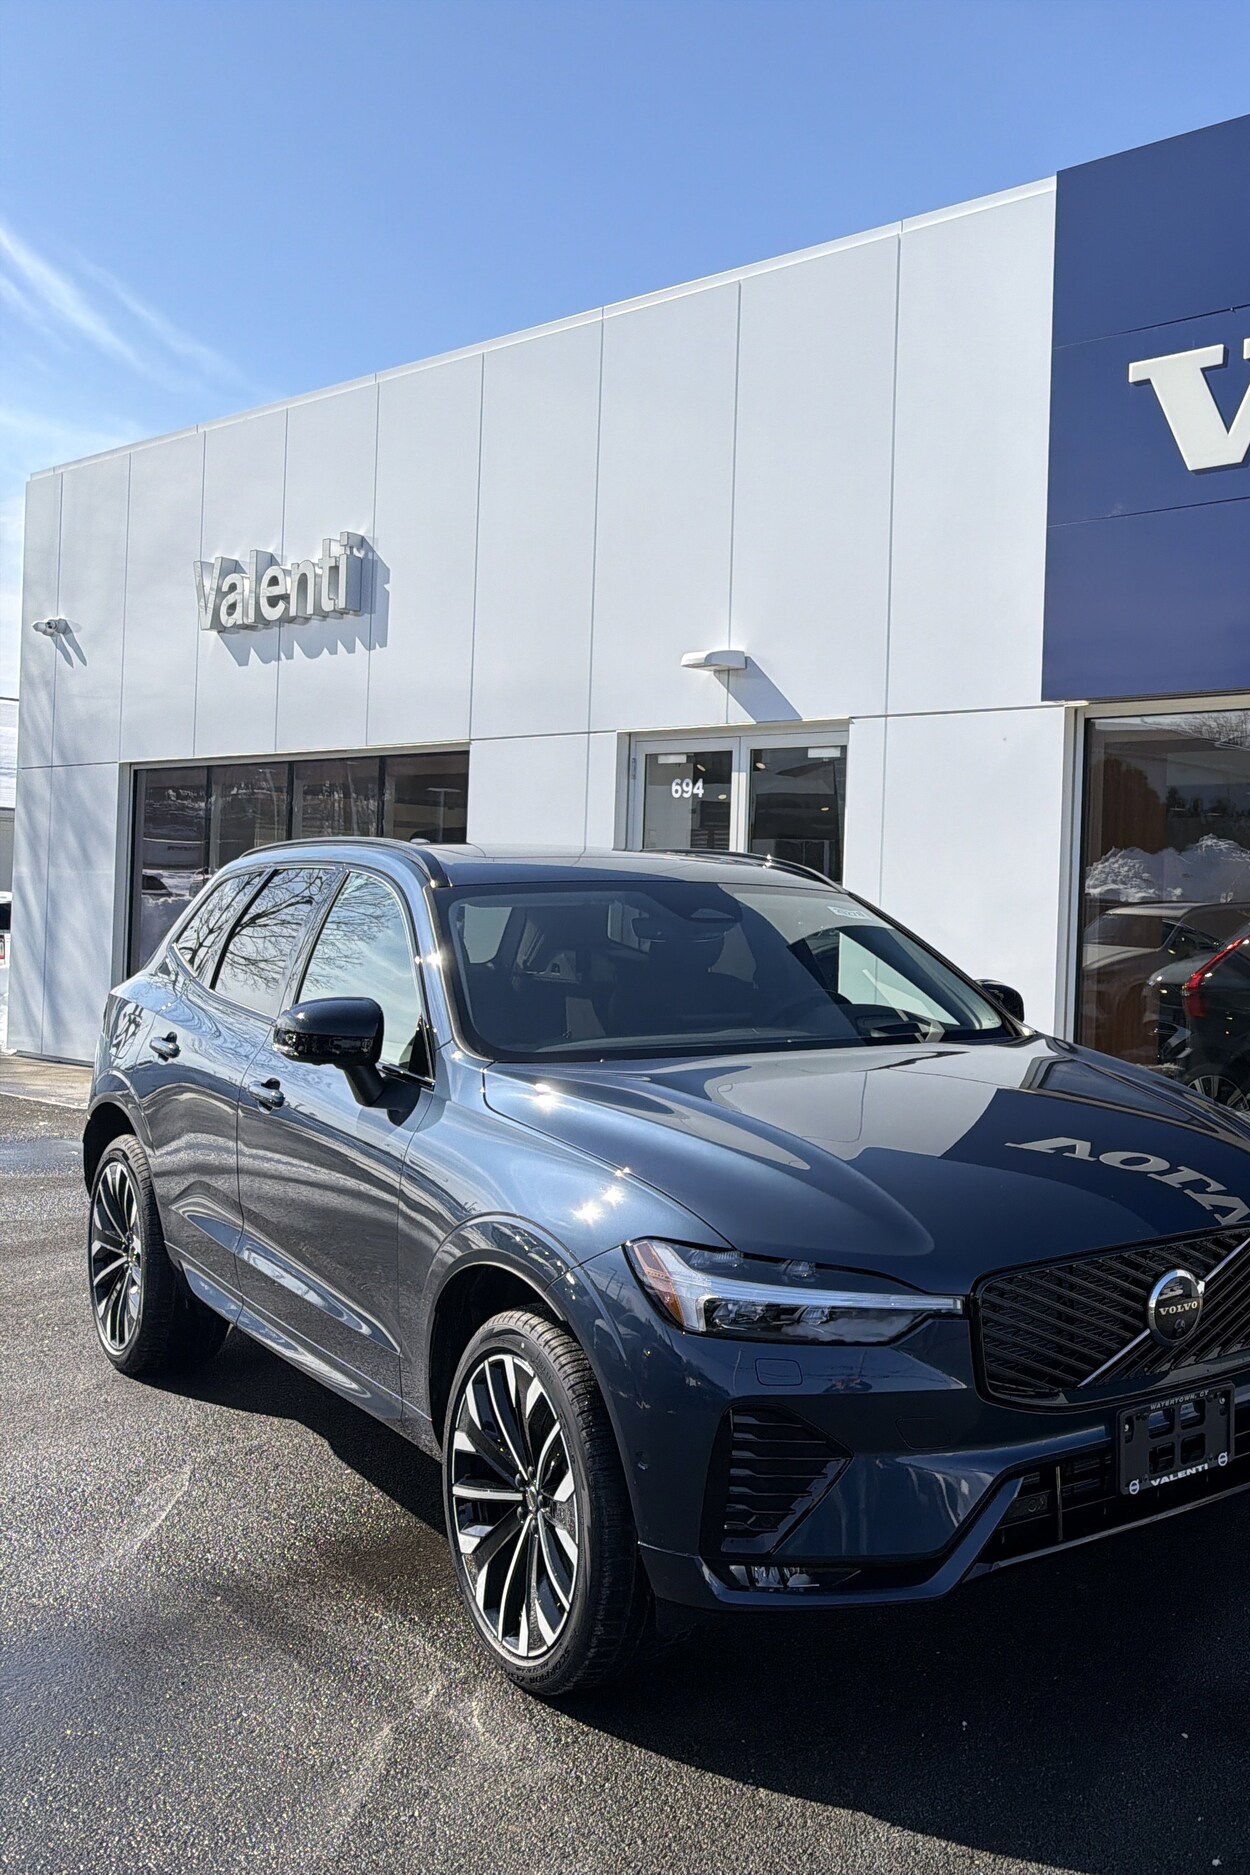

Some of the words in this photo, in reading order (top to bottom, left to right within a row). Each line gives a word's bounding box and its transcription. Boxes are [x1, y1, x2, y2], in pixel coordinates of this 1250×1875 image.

[193, 531, 364, 632] Valenti
[671, 778, 705, 799] 694
[1159, 1301, 1198, 1316] VOLVO
[1150, 1463, 1209, 1487] VALENTI
